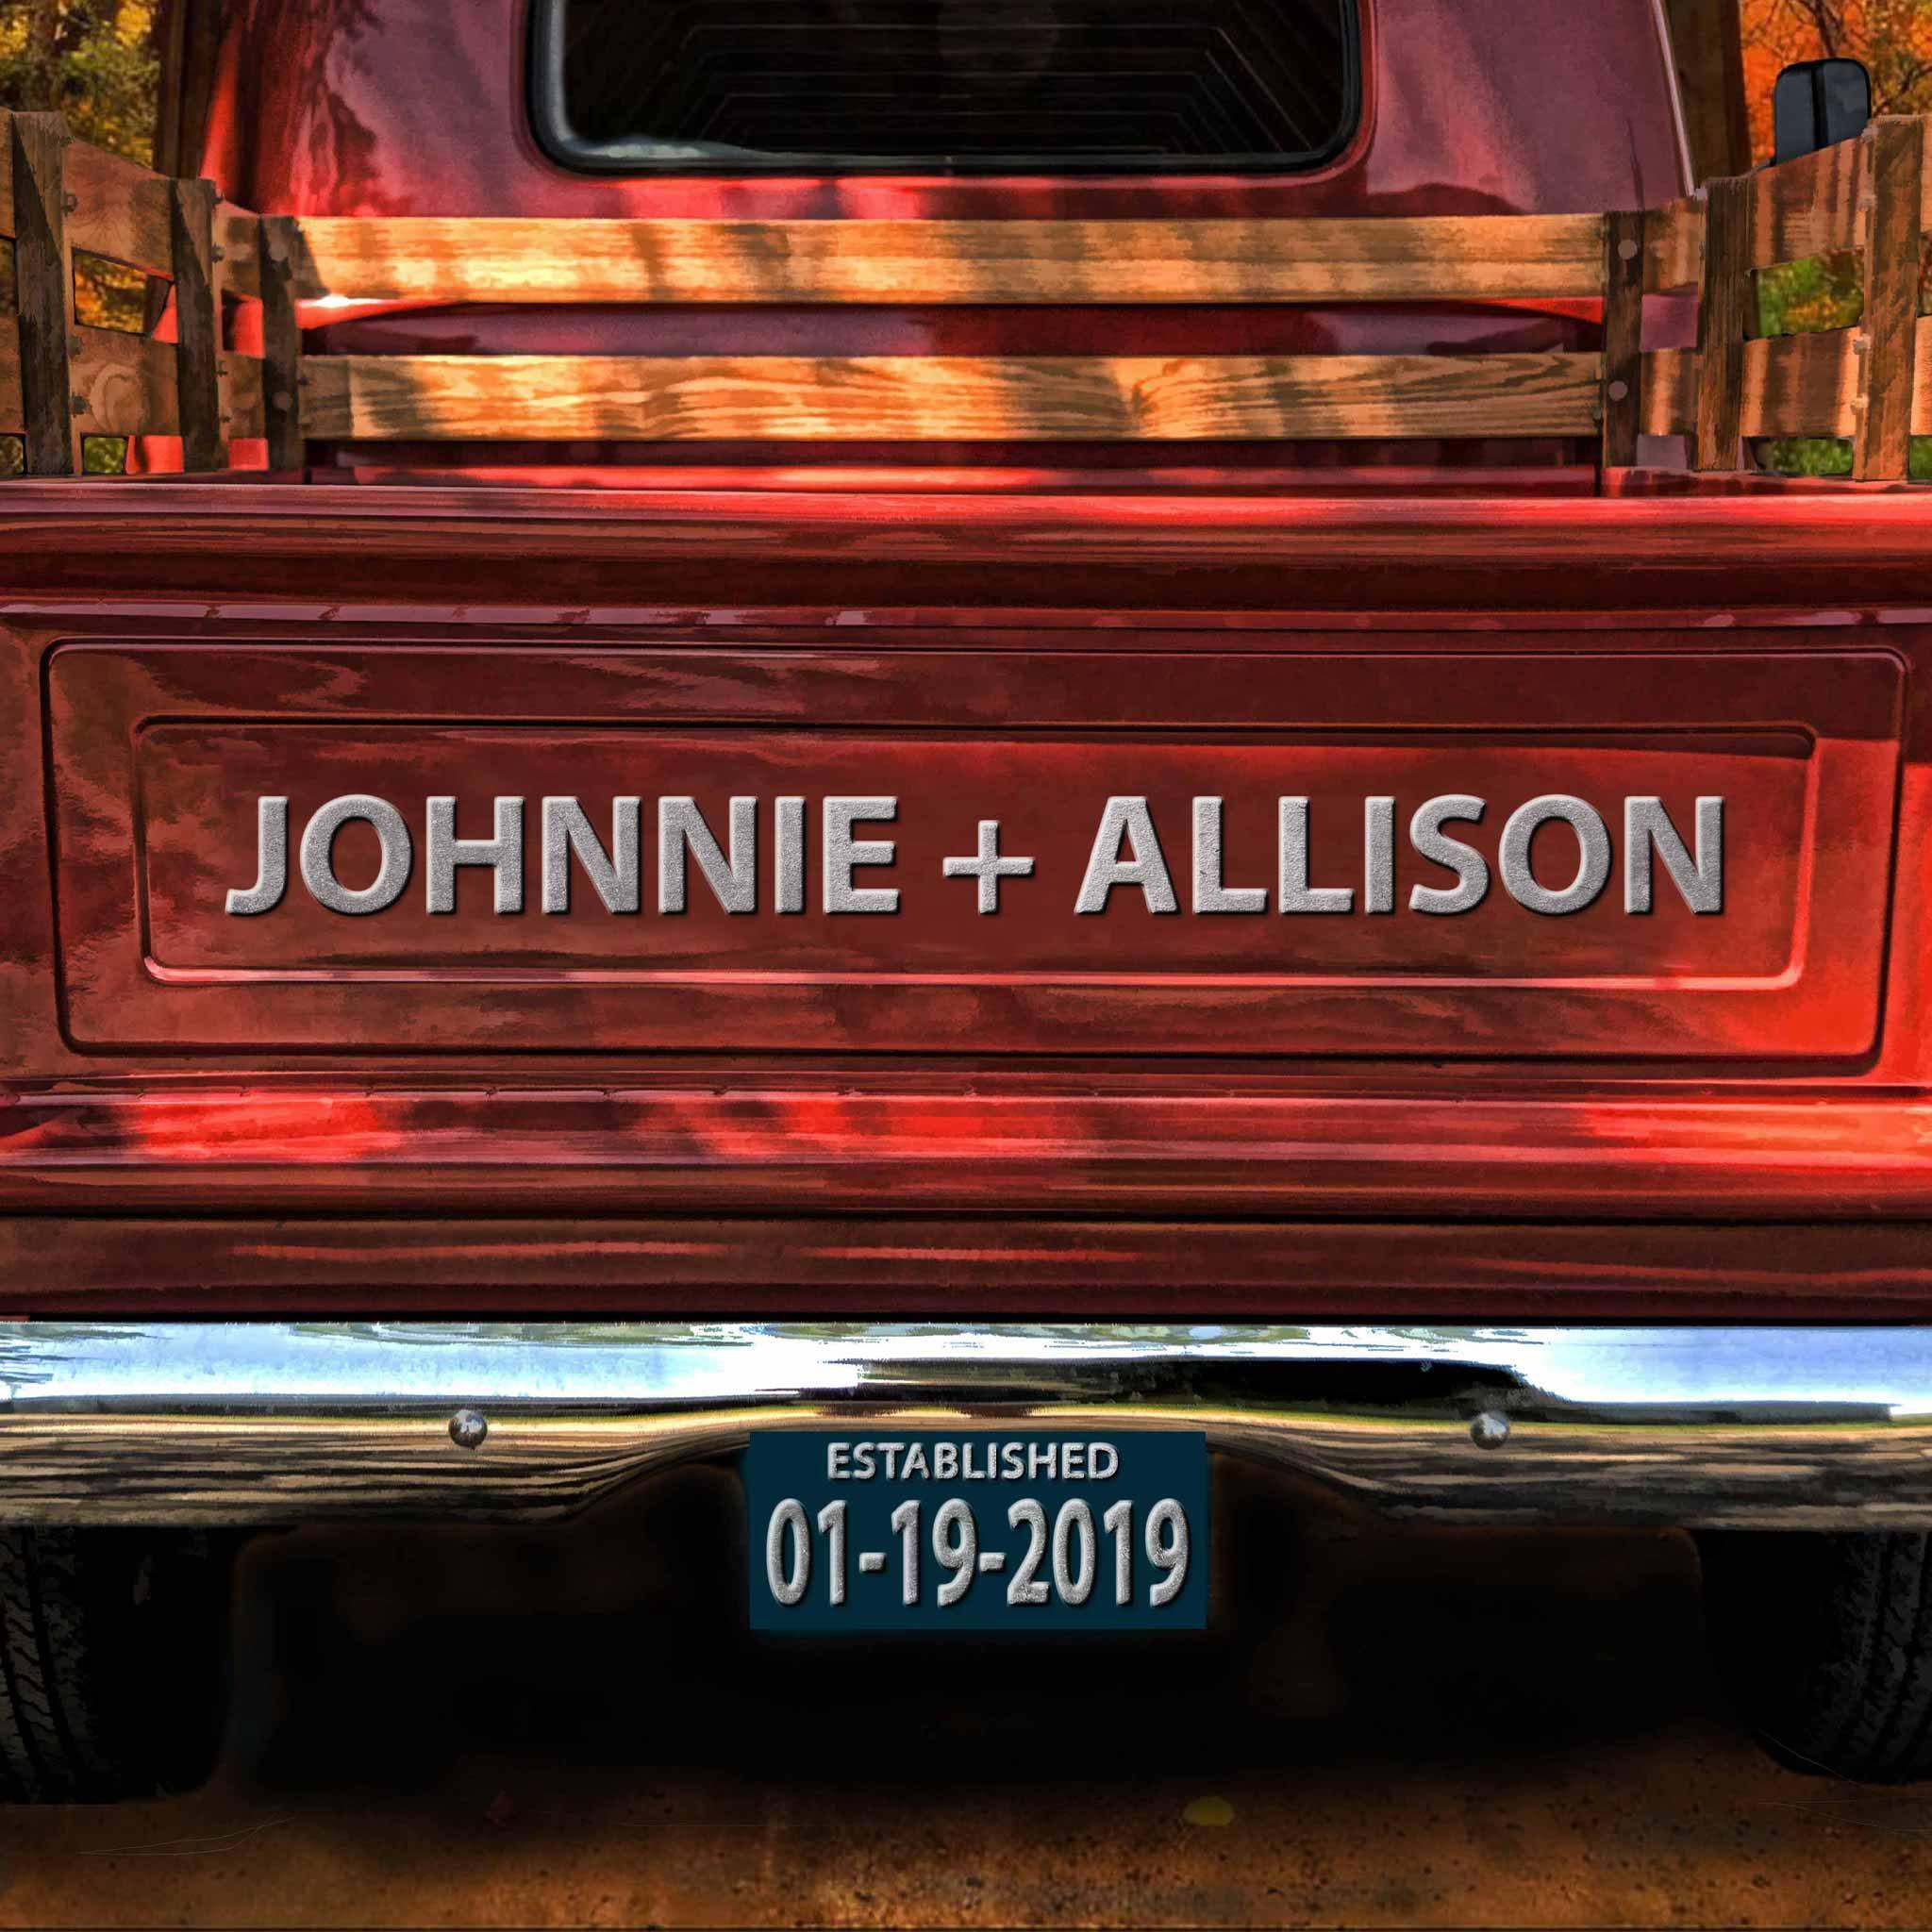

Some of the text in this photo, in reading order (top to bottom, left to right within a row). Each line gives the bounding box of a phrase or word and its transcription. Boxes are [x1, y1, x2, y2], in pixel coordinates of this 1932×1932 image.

[225, 793, 1724, 915] JOHNNIE + ALLISON
[826, 1441, 1120, 1480] ESTABLISHED
[765, 1497, 1190, 1607] 01-19-2019
